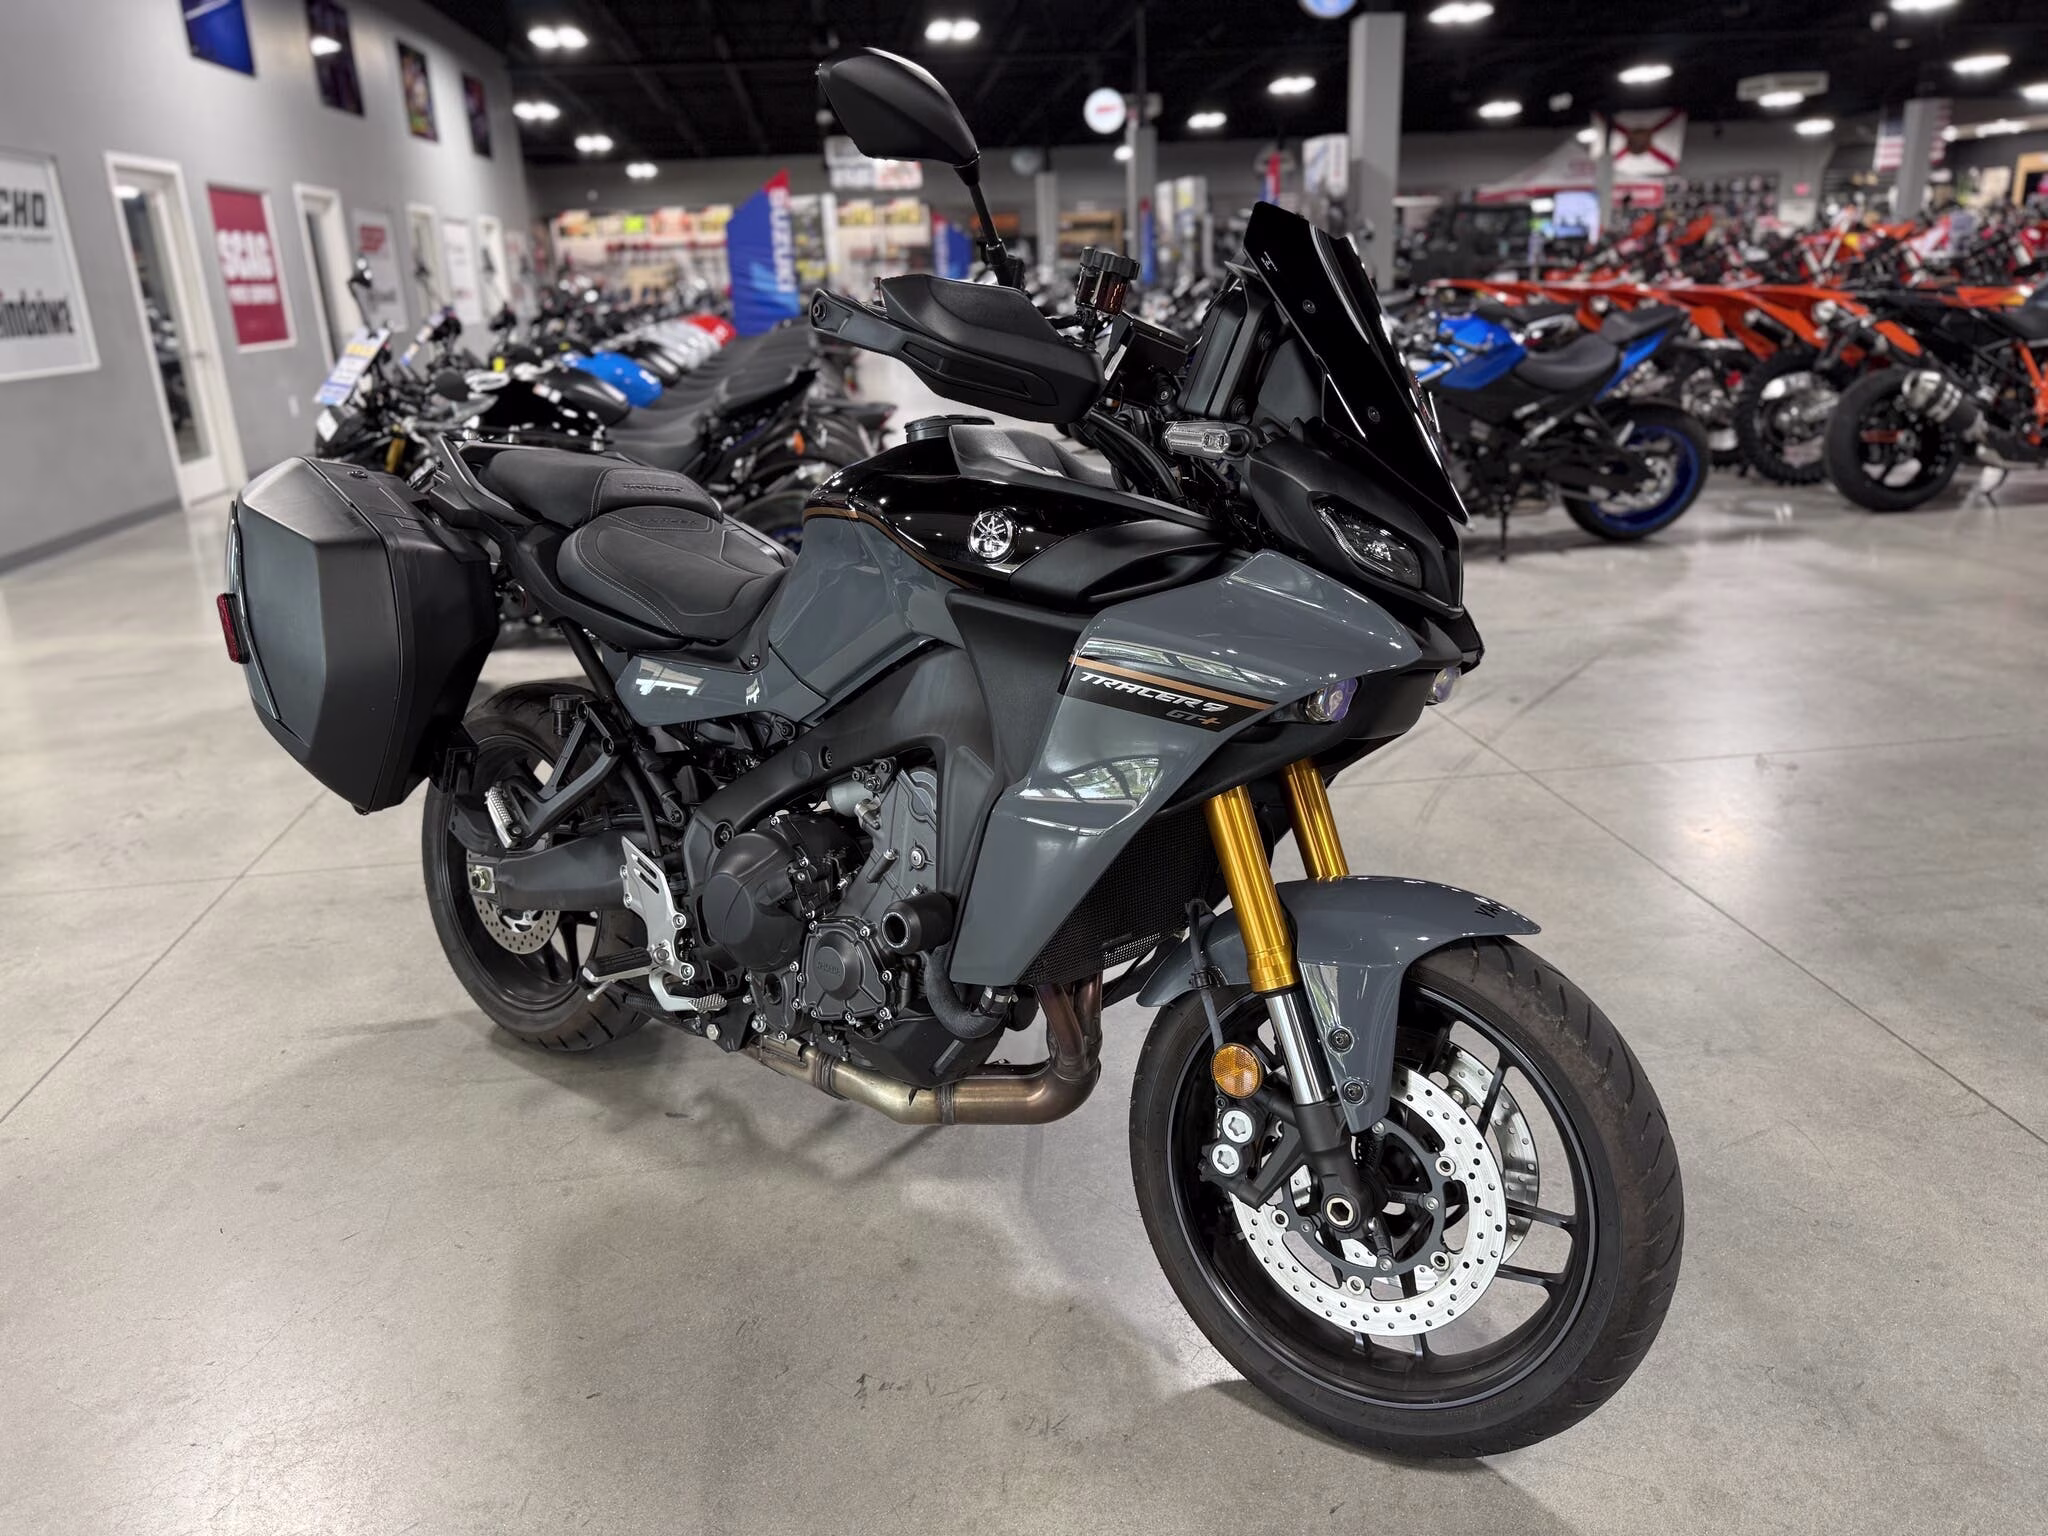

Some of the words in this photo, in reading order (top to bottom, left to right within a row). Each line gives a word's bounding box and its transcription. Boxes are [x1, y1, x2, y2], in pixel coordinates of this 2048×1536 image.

[768, 187, 796, 292] SUZUKI
[1080, 671, 1203, 708] TRACER
[1202, 702, 1229, 712] 9
[1165, 709, 1221, 725] GT+
